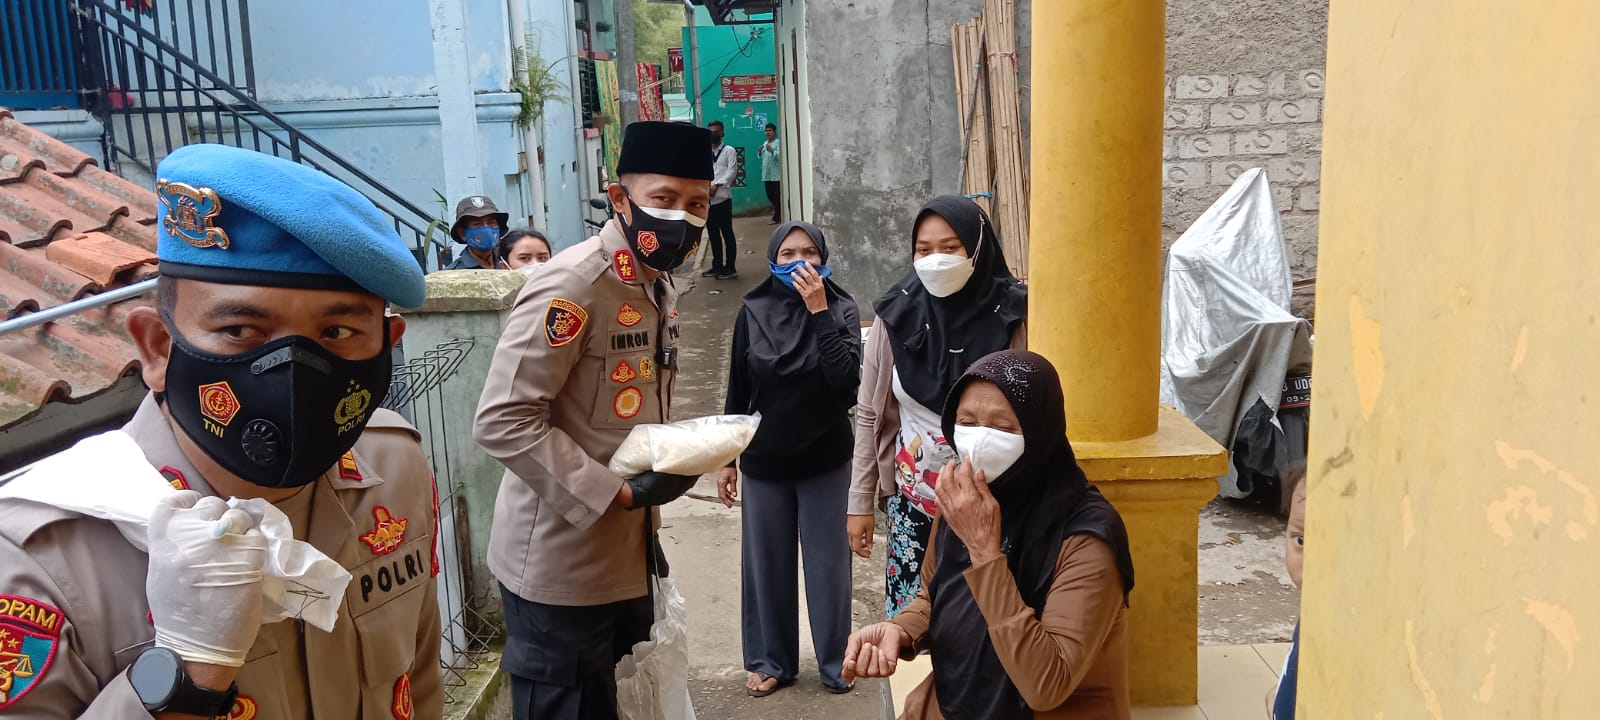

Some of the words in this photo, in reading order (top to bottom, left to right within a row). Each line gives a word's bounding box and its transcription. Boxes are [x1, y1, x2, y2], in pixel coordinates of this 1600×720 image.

[637, 246, 649, 257] TNI
[611, 331, 649, 350] IMRON
[1295, 378, 1312, 390] UD
[202, 418, 225, 438] TNI
[337, 413, 366, 436] POLRI
[360, 549, 425, 603] POLRI
